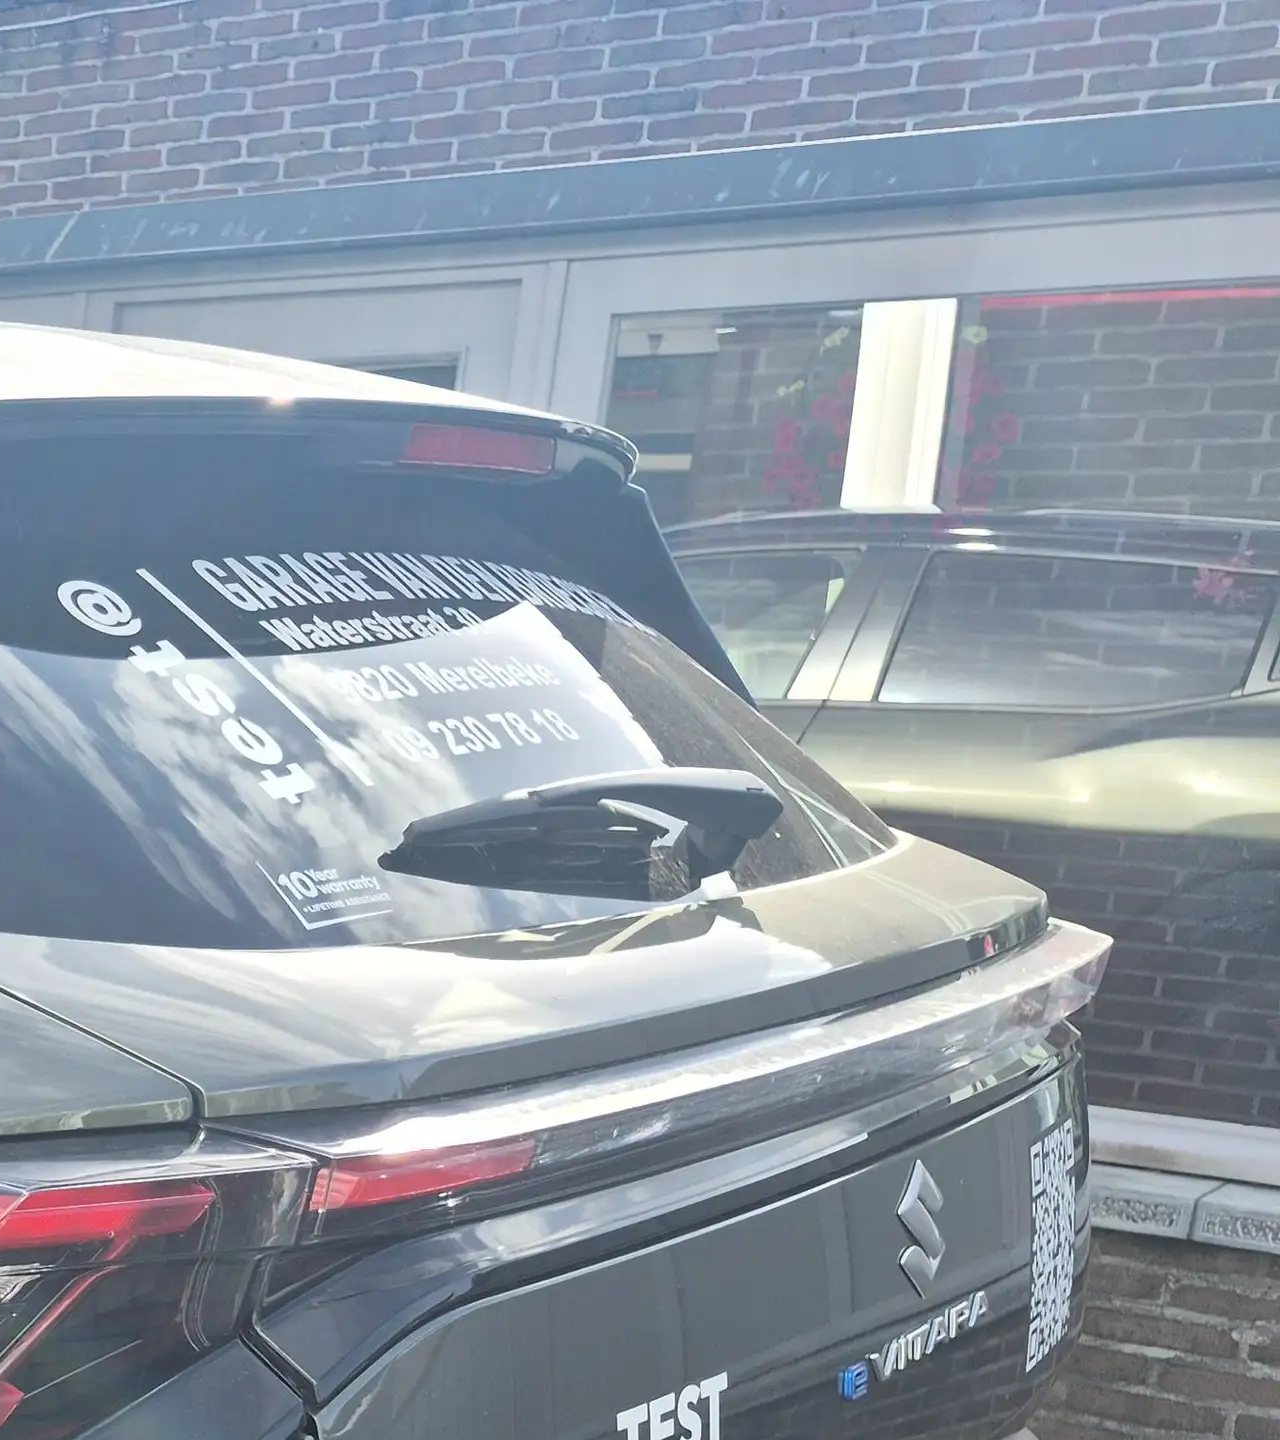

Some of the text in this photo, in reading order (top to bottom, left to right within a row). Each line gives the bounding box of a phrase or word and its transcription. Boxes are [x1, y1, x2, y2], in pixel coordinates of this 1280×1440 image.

[191, 551, 396, 612] GARAGE
[347, 551, 463, 600] VAN
[419, 554, 522, 604] DEN
[258, 607, 450, 651] Waterstraat
[403, 656, 562, 695] Merelbeke
[382, 707, 581, 763] 09 230 78 18
[277, 870, 319, 901] 10
[304, 868, 340, 882] Year
[316, 875, 381, 895] warranty
[864, 1290, 990, 1383] VITARA
